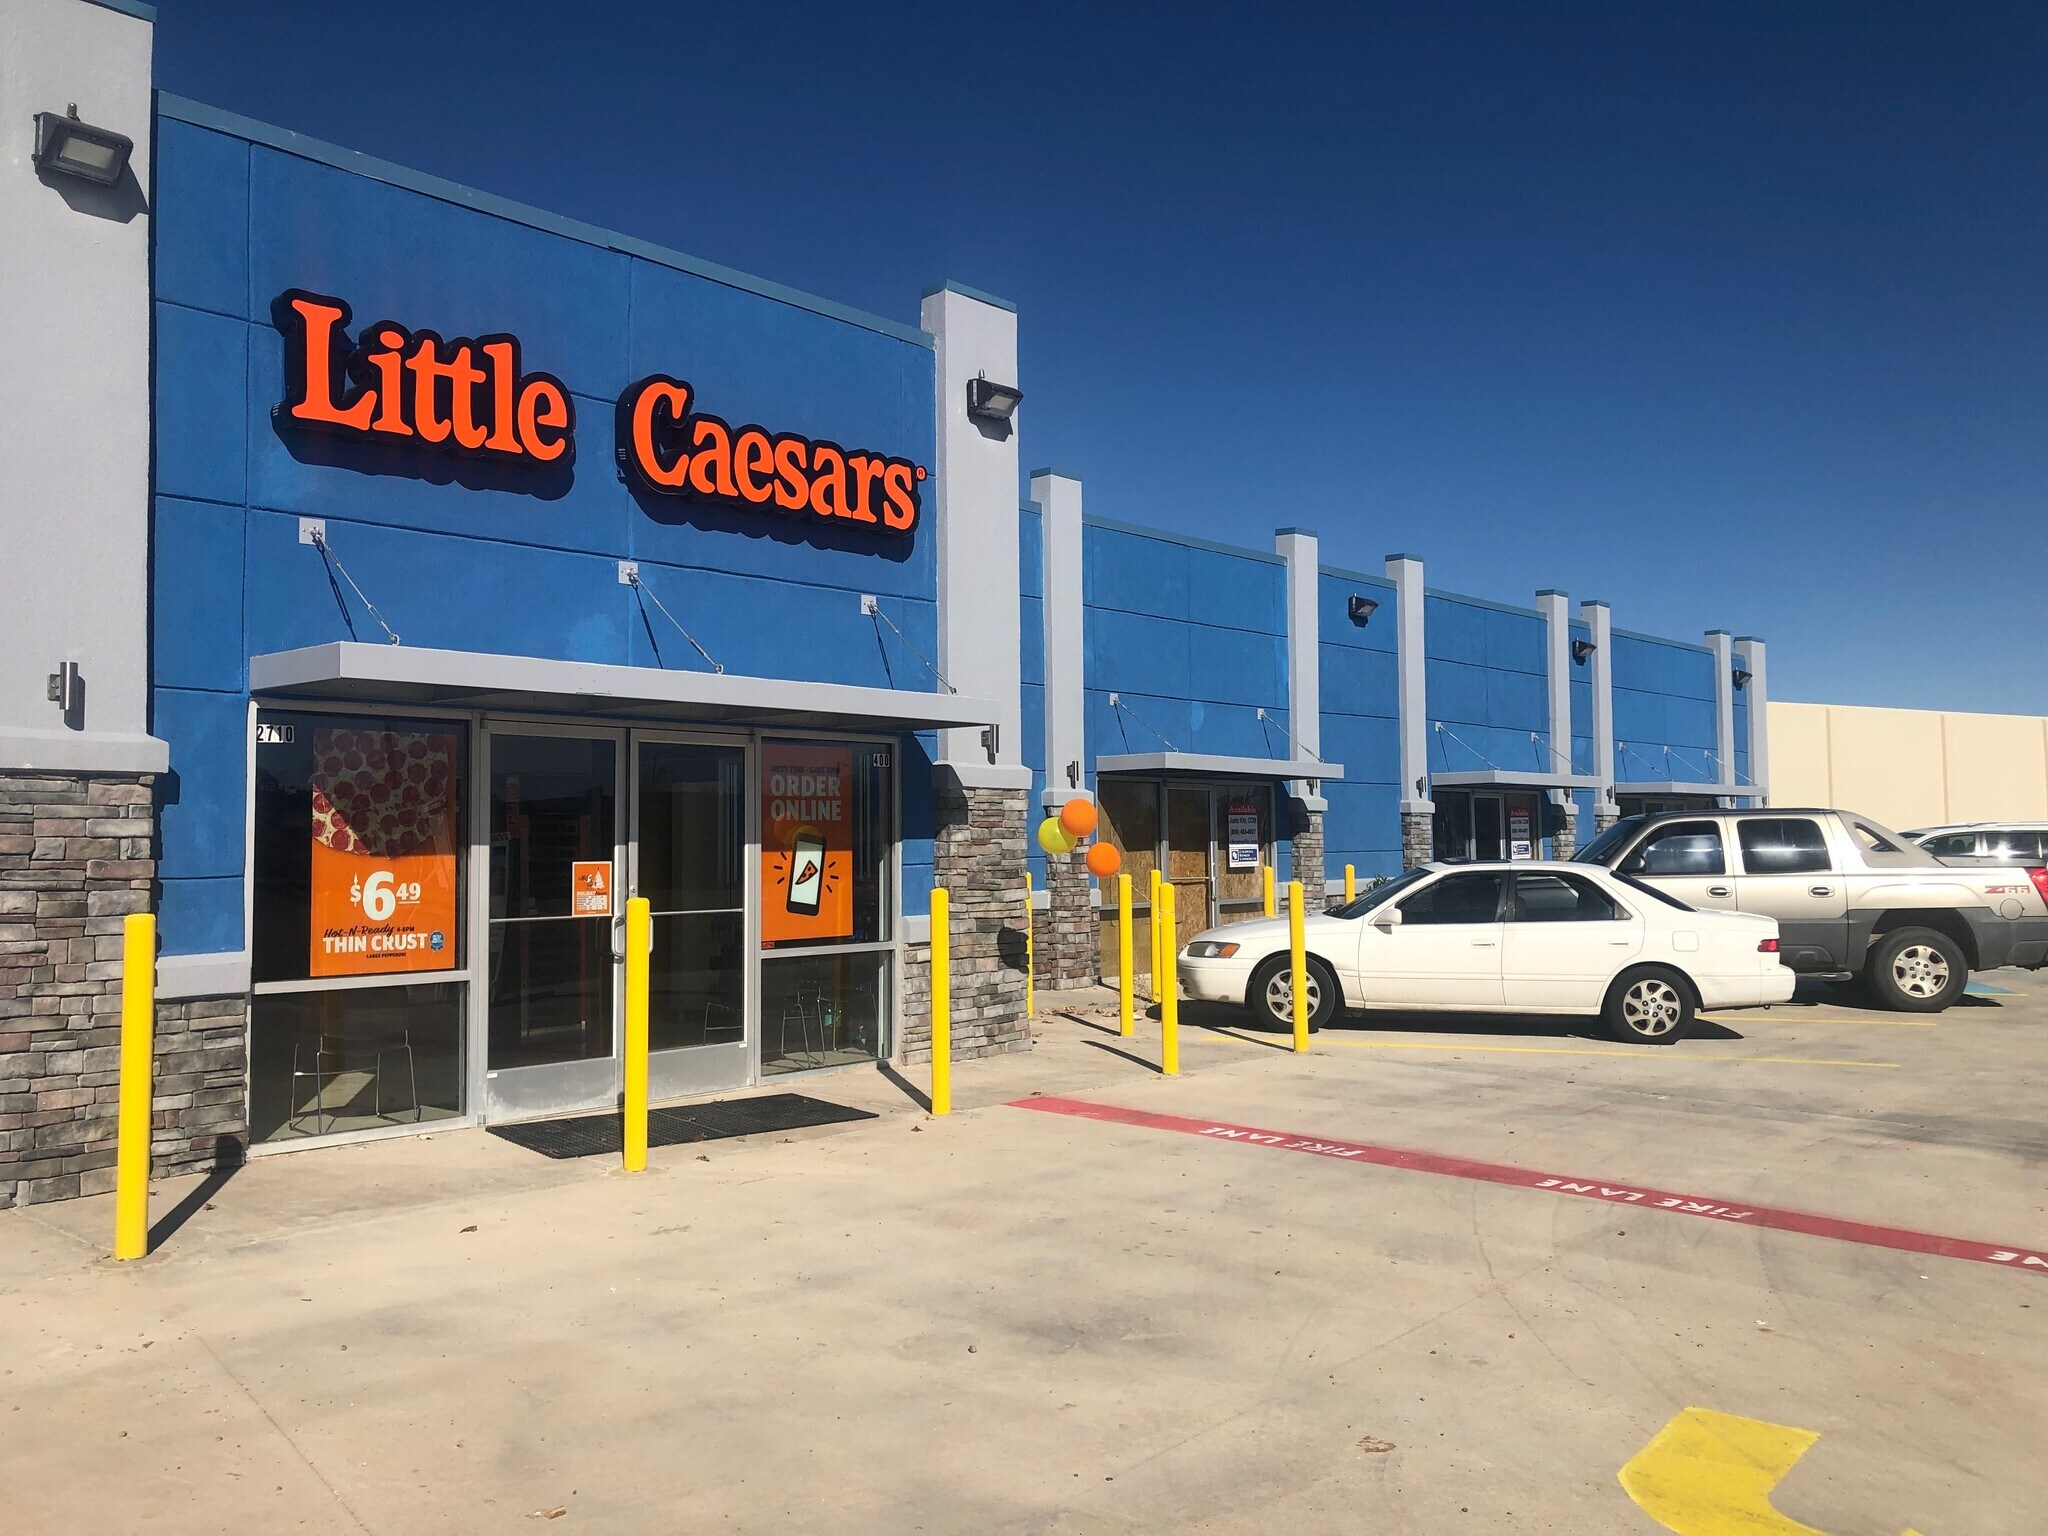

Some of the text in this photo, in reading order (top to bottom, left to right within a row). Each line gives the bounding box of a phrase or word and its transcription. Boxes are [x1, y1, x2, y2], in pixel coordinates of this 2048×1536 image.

[291, 298, 916, 531] Little Caesars
[256, 724, 293, 742] 2710
[873, 753, 890, 768] 400
[770, 774, 841, 797] ORDER
[770, 799, 842, 821] ONLINE
[323, 923, 394, 938] Hot-N-Ready
[323, 935, 367, 953] THIN
[371, 933, 428, 951] CRUST
[1198, 1127, 1366, 1157] FIRE LANE
[1534, 1178, 1755, 1219] FIRE LANE
